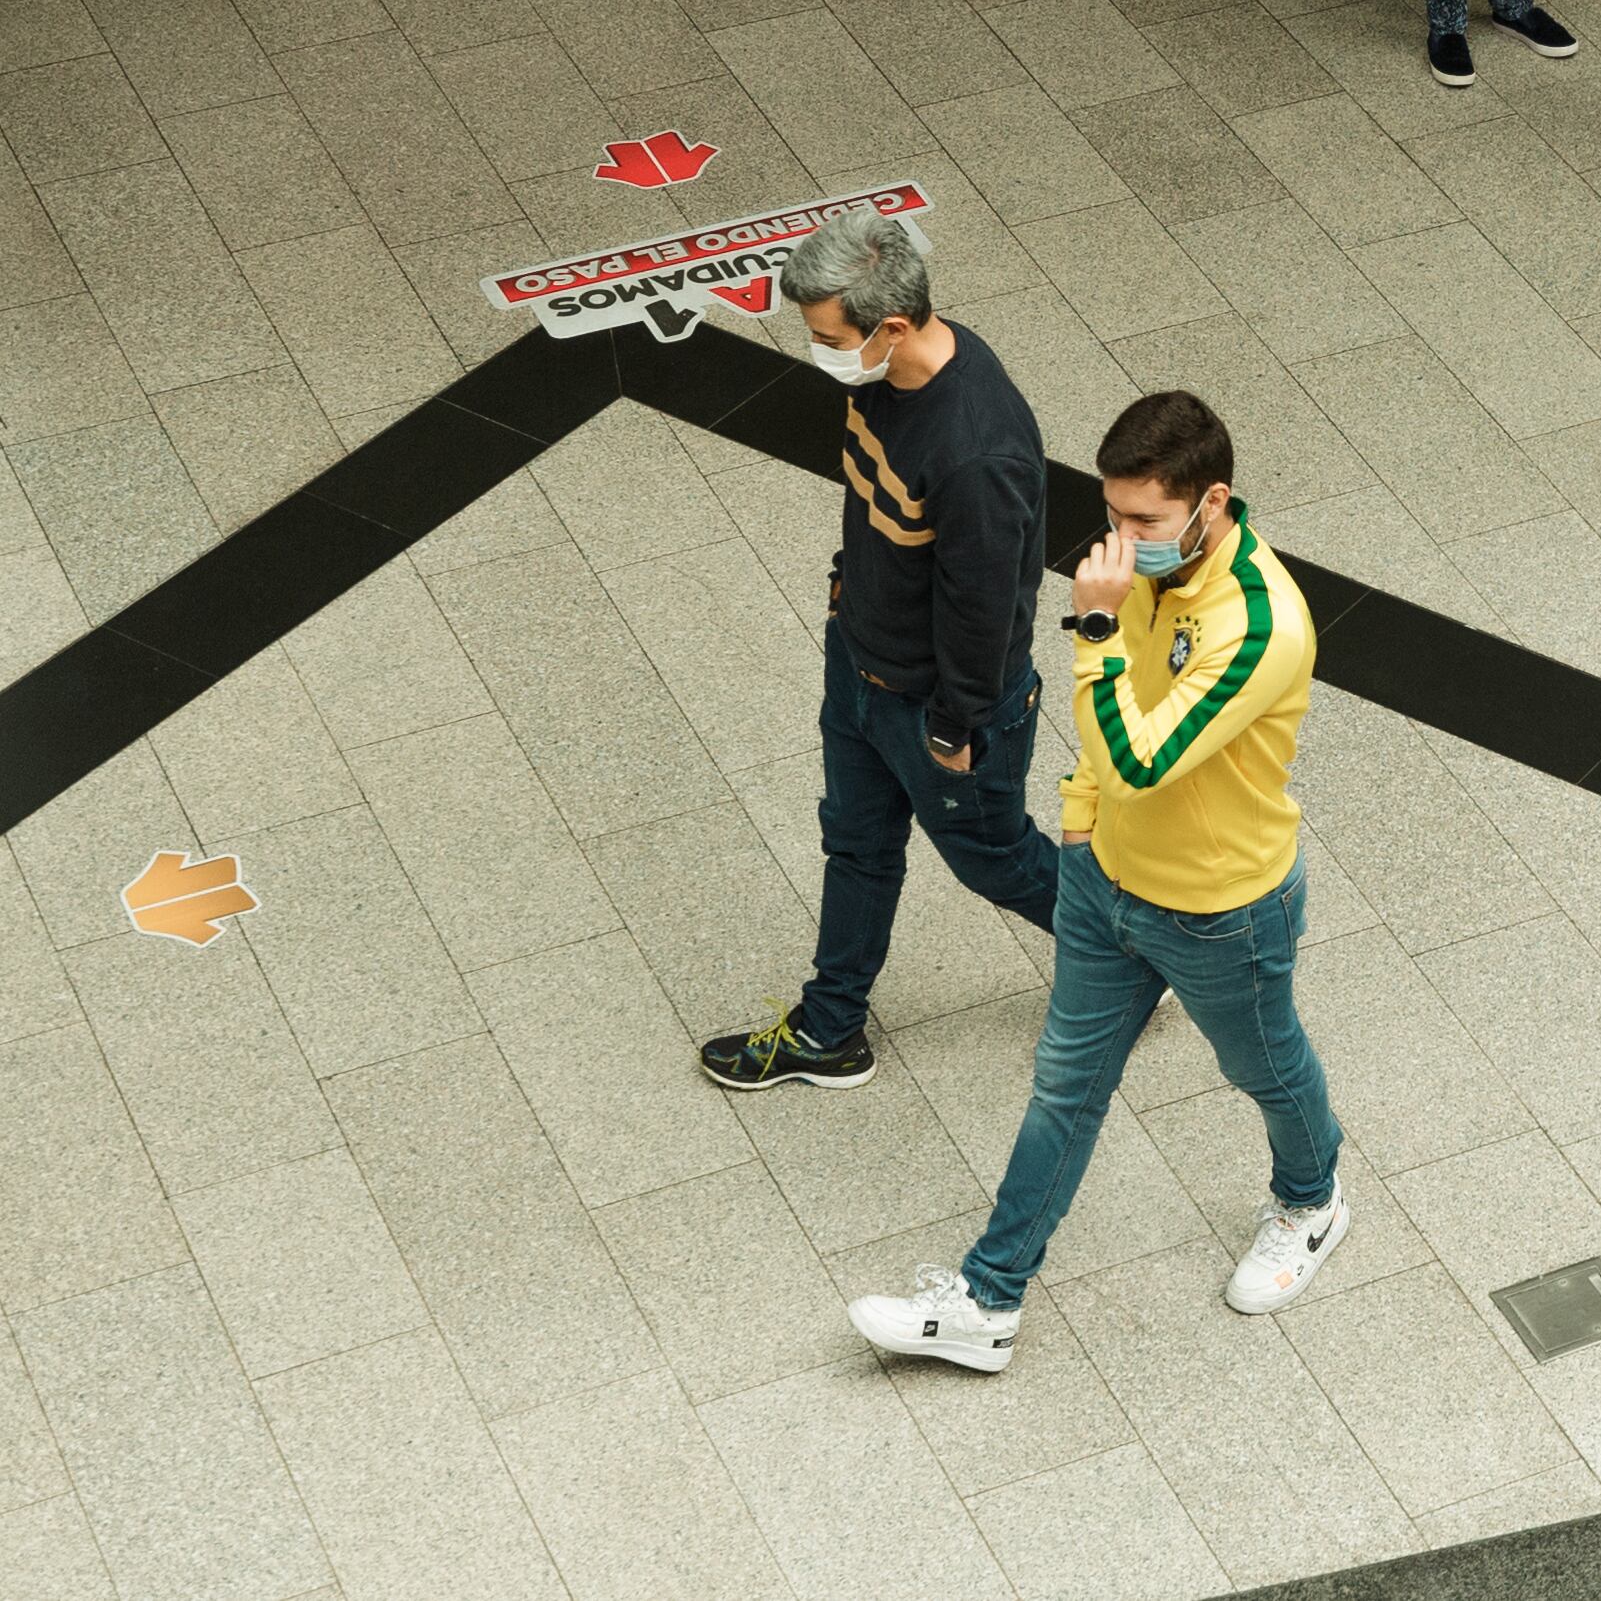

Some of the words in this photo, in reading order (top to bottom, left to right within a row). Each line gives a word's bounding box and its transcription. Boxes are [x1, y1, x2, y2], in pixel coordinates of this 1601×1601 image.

[514, 252, 635, 294] PASO
[632, 243, 692, 265] EL
[548, 245, 793, 318] CUIDAMOS
